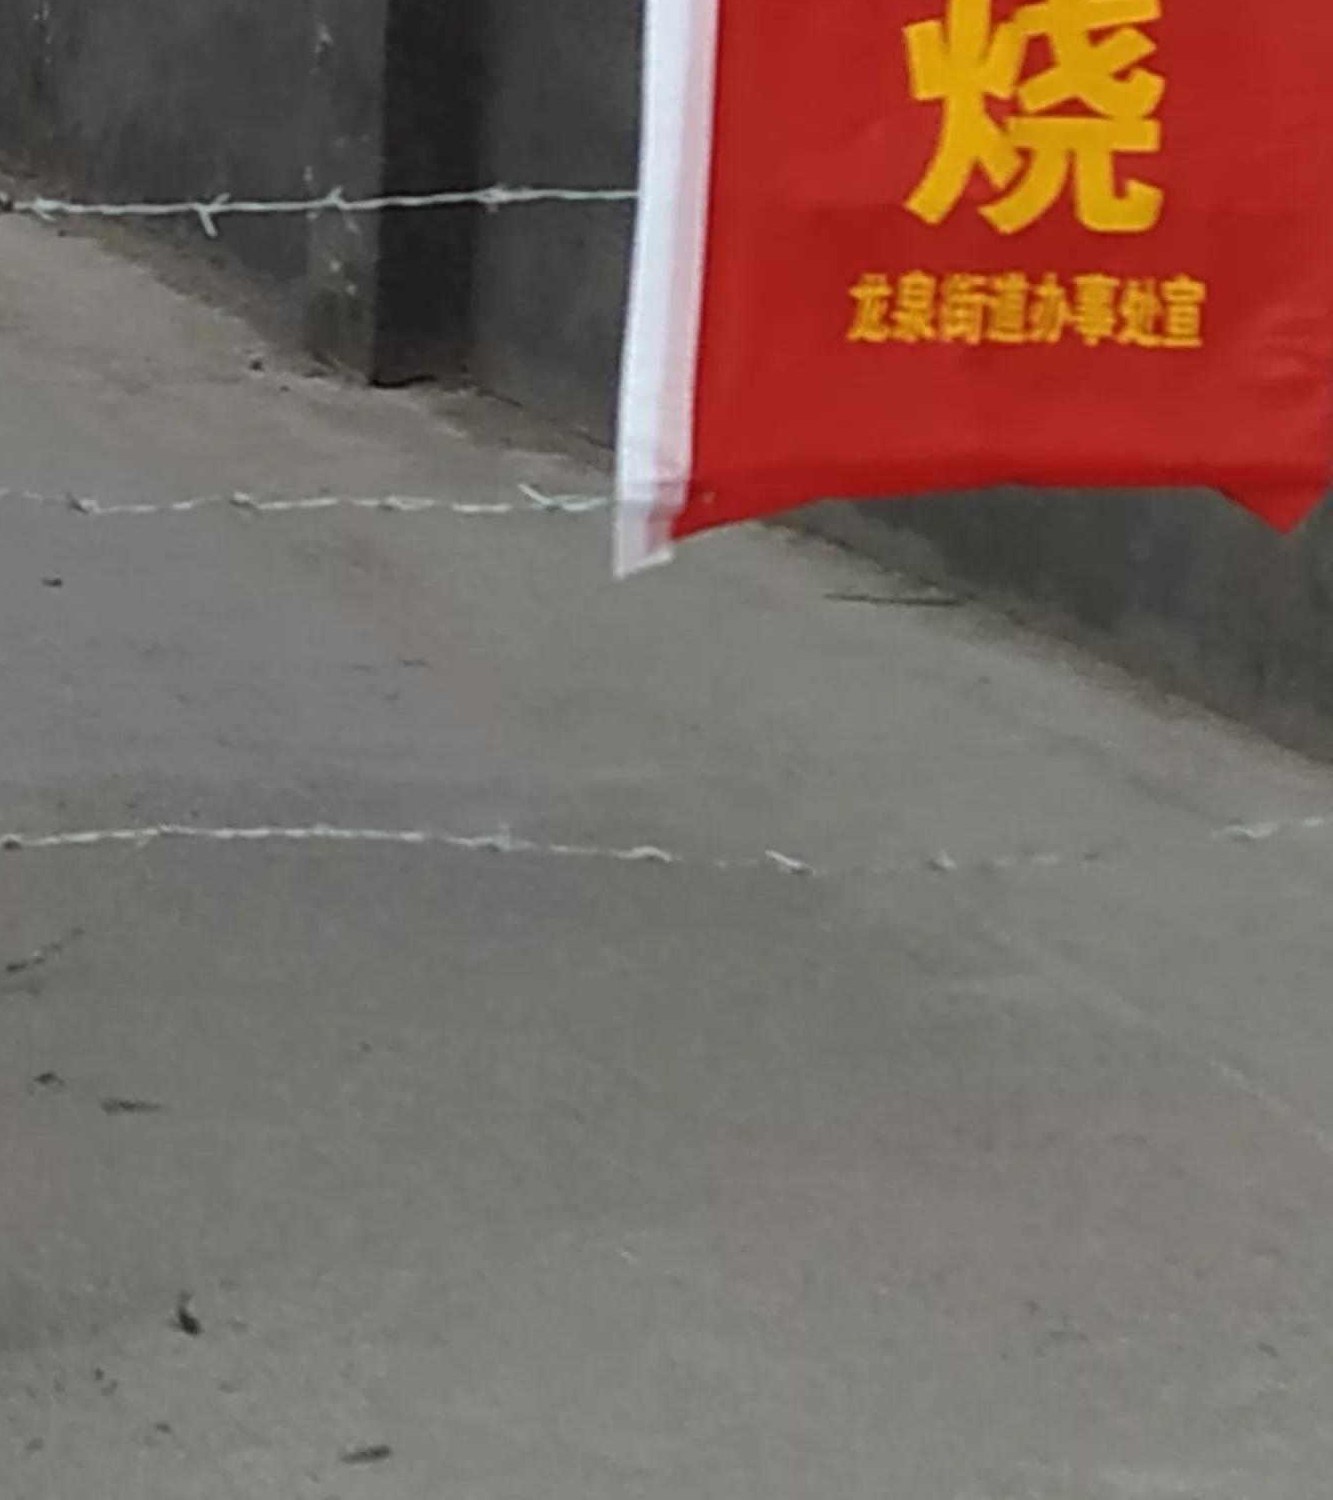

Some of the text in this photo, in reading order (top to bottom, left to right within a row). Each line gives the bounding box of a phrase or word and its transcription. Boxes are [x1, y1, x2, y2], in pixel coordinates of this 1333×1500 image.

[846, 268, 1207, 349] 龙泉街道办事处宣
